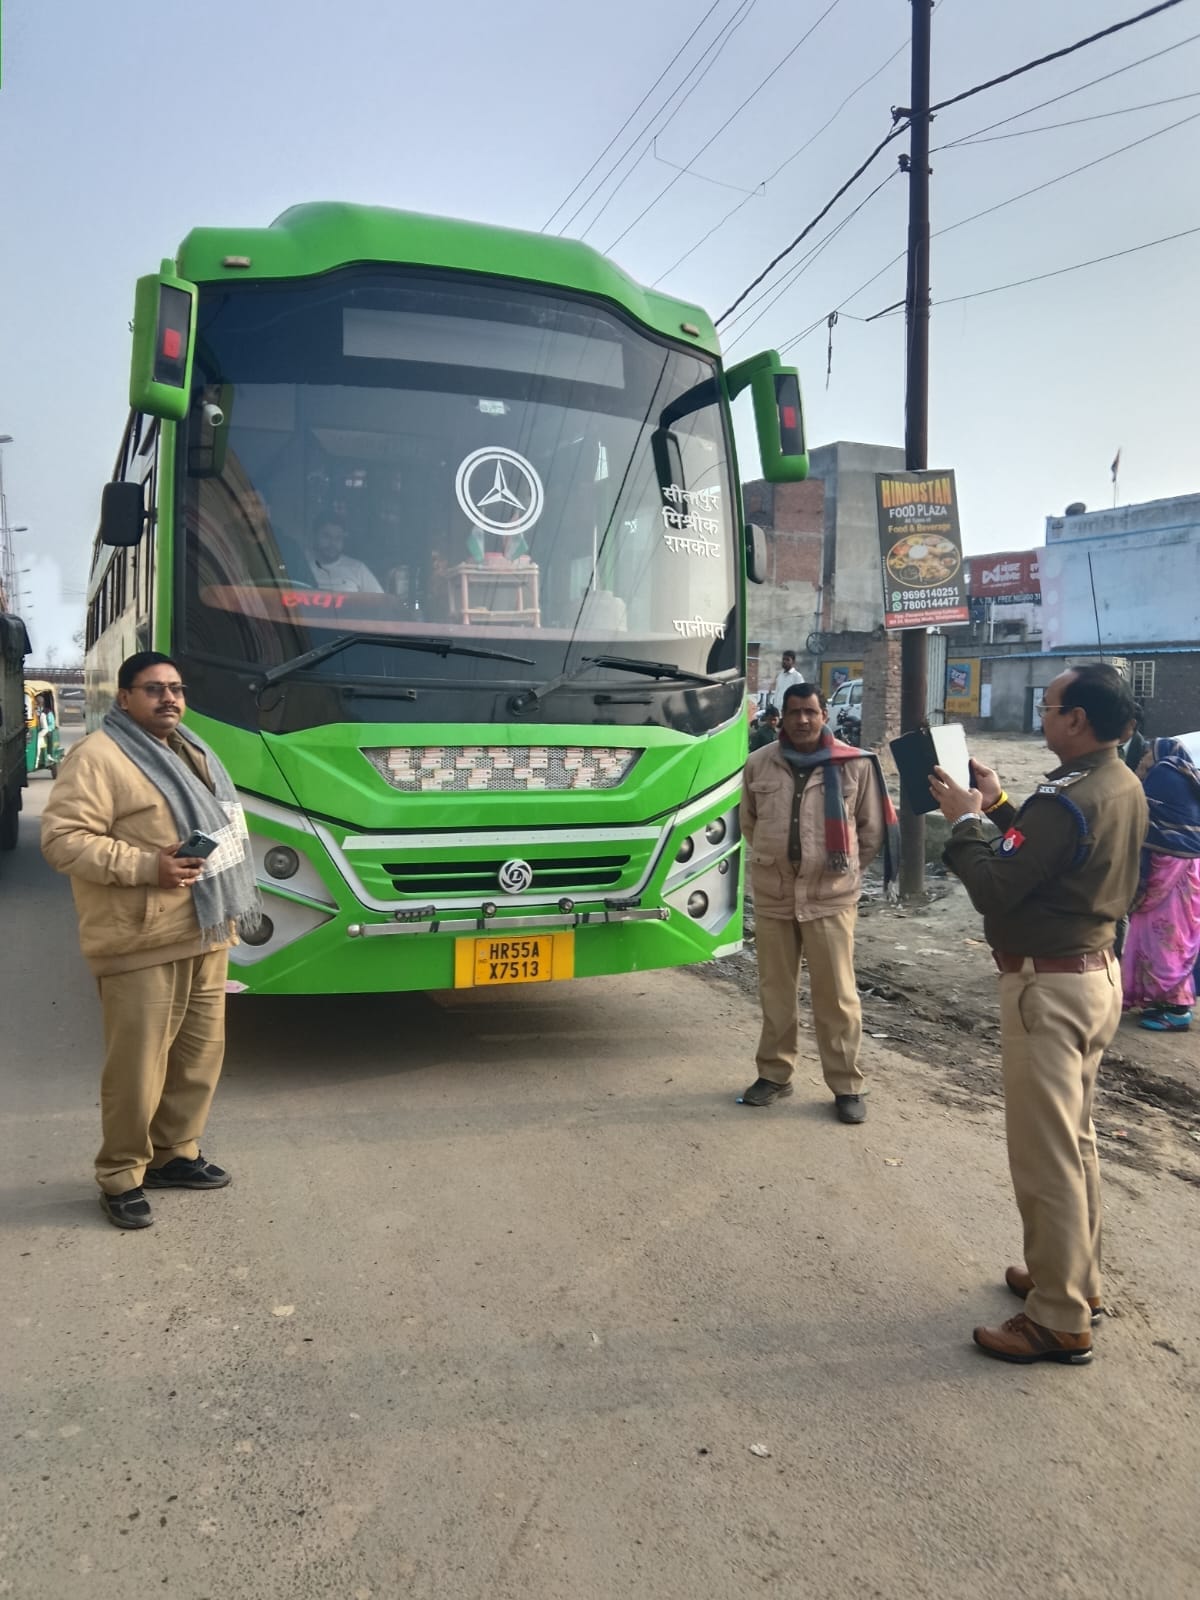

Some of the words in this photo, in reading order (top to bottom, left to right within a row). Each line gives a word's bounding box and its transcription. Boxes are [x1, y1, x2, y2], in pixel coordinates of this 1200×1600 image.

[662, 484, 719, 511] सीतापुर
[881, 478, 951, 508] HINDUSTAN
[889, 504, 916, 518] FOOD
[917, 504, 947, 516] PLAZA
[888, 525, 908, 533] Food
[664, 533, 720, 557] रामकोट
[902, 587, 959, 600] 9696140251
[903, 597, 960, 610] 7800144477
[673, 615, 726, 640] पानीपत
[489, 942, 539, 960] HR55A
[489, 961, 539, 979] X7513
